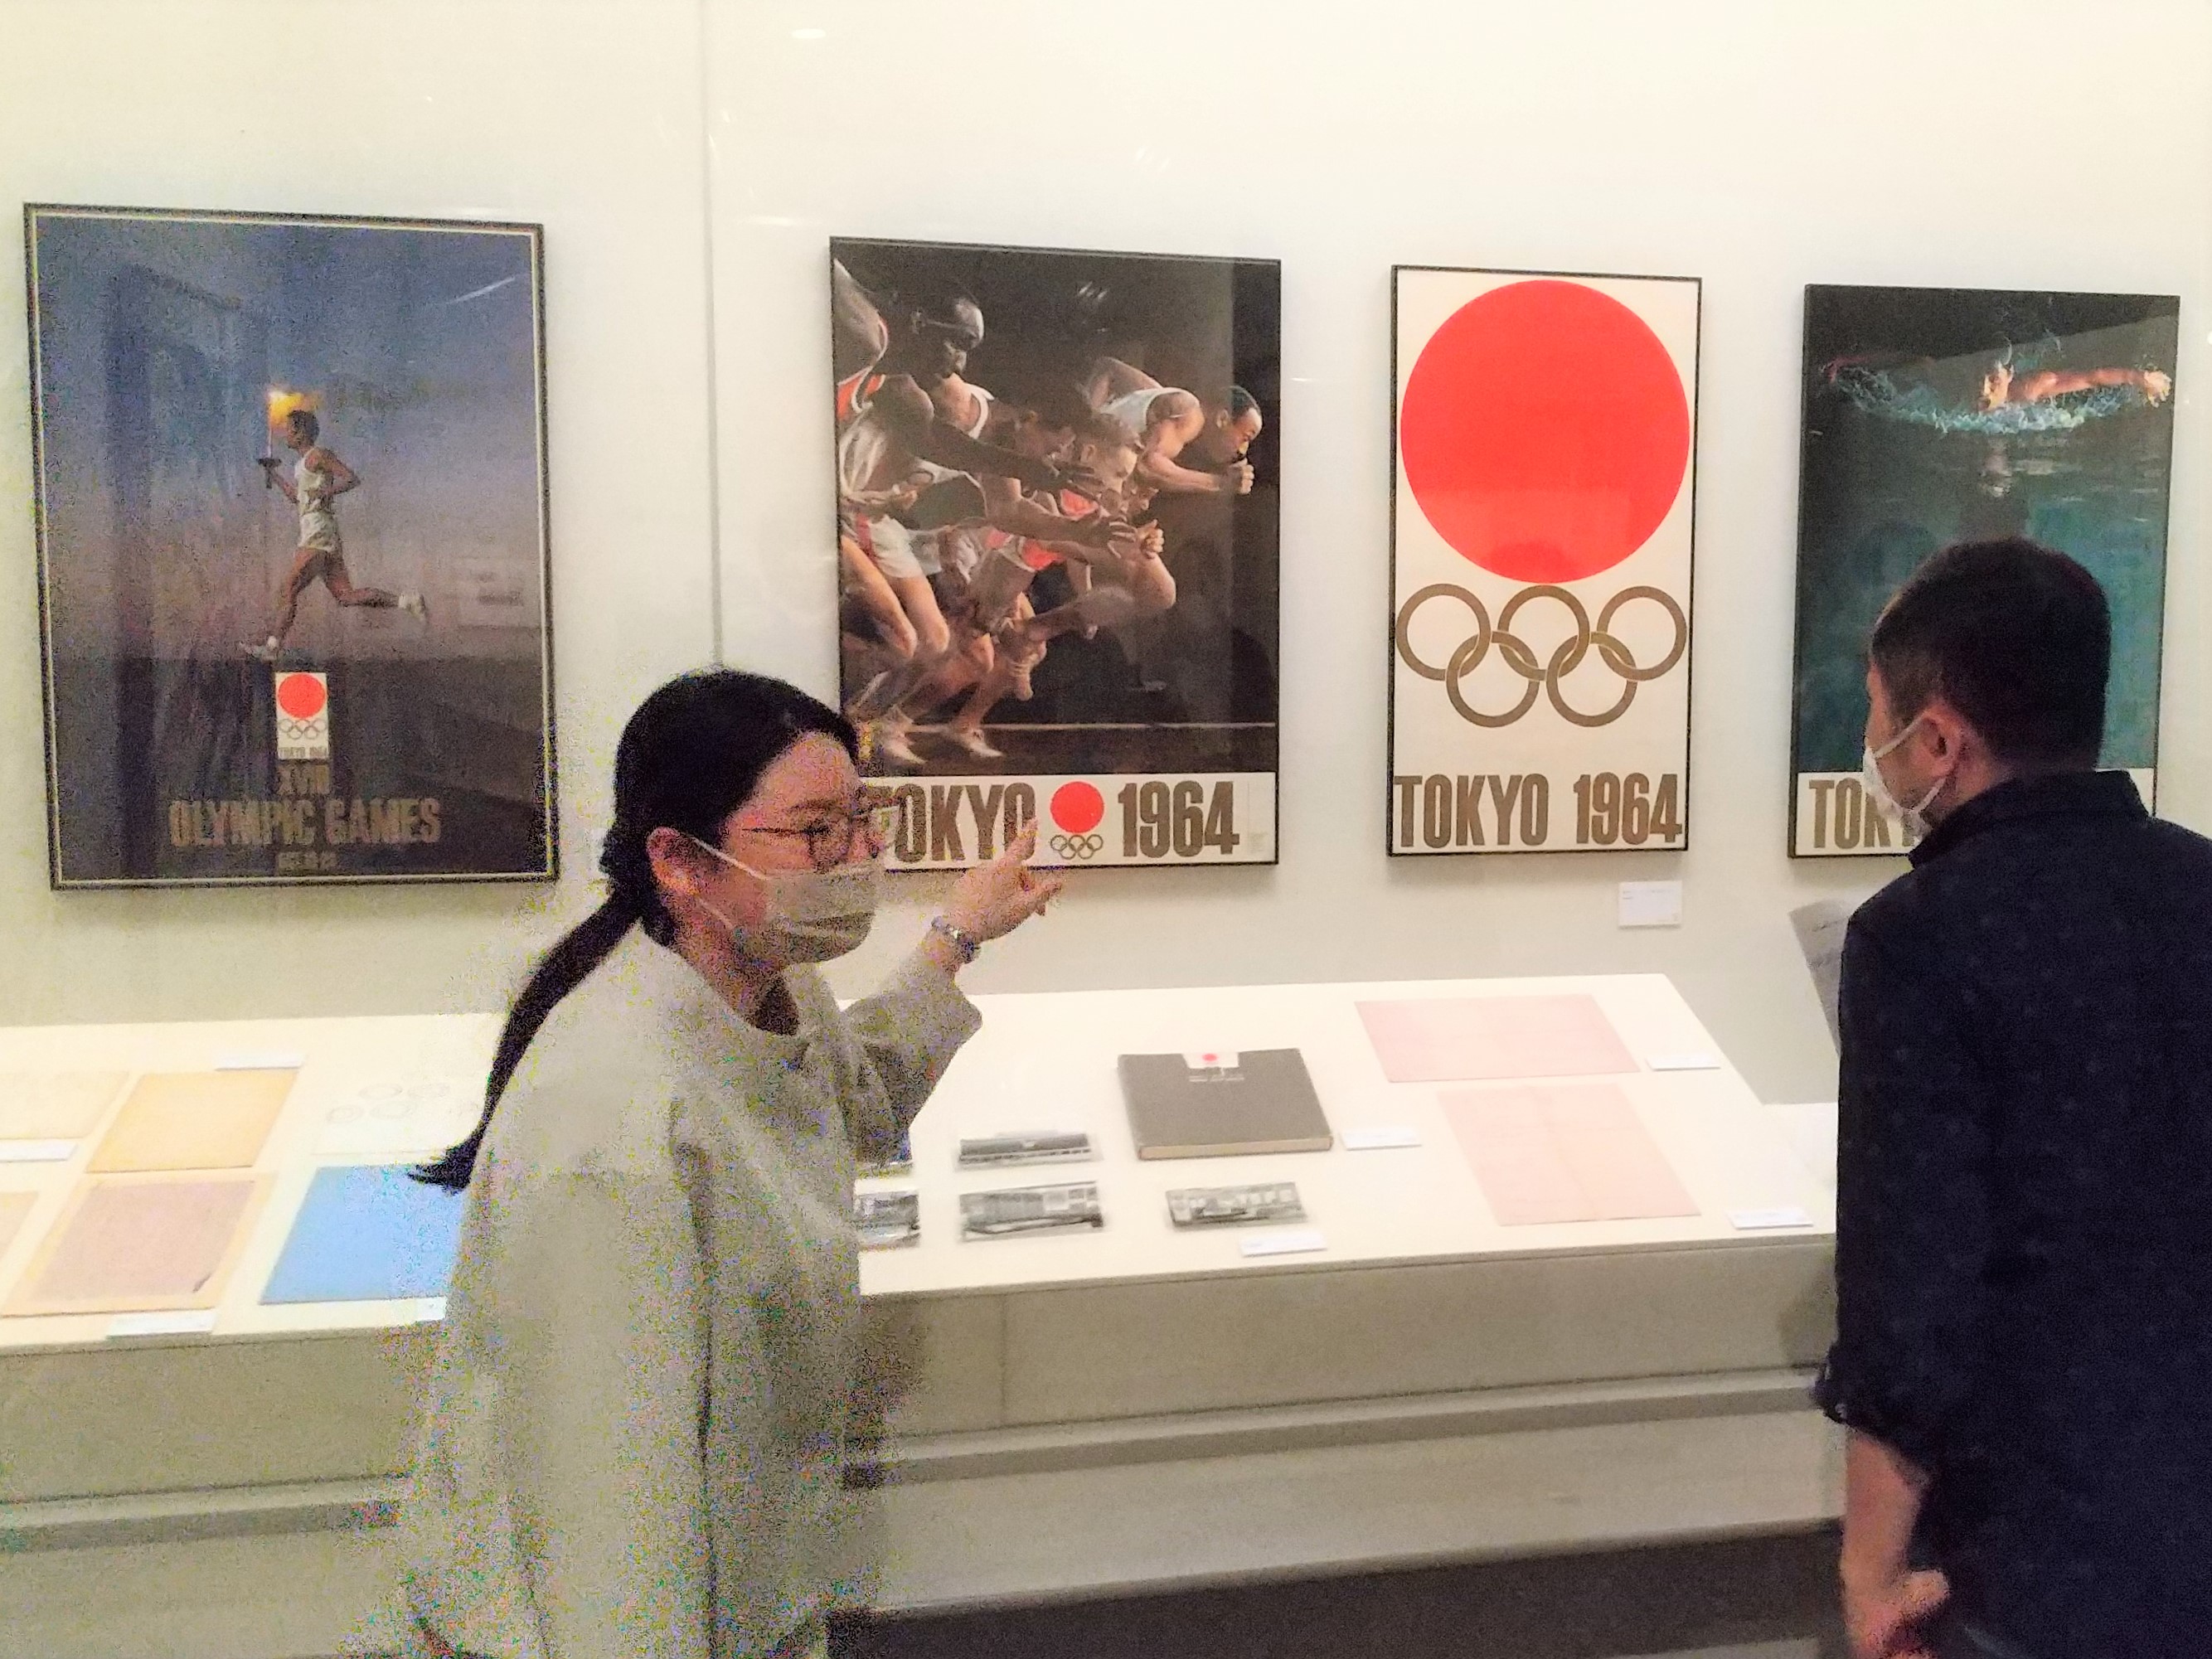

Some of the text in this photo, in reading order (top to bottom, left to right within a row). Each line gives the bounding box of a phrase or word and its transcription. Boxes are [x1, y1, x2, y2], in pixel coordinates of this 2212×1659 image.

[169, 798, 440, 846] OLYMPIC GAMES
[1118, 780, 1239, 857] 1964
[1394, 772, 1682, 848] TOKYO 1964
[1809, 777, 1915, 849] TOK
